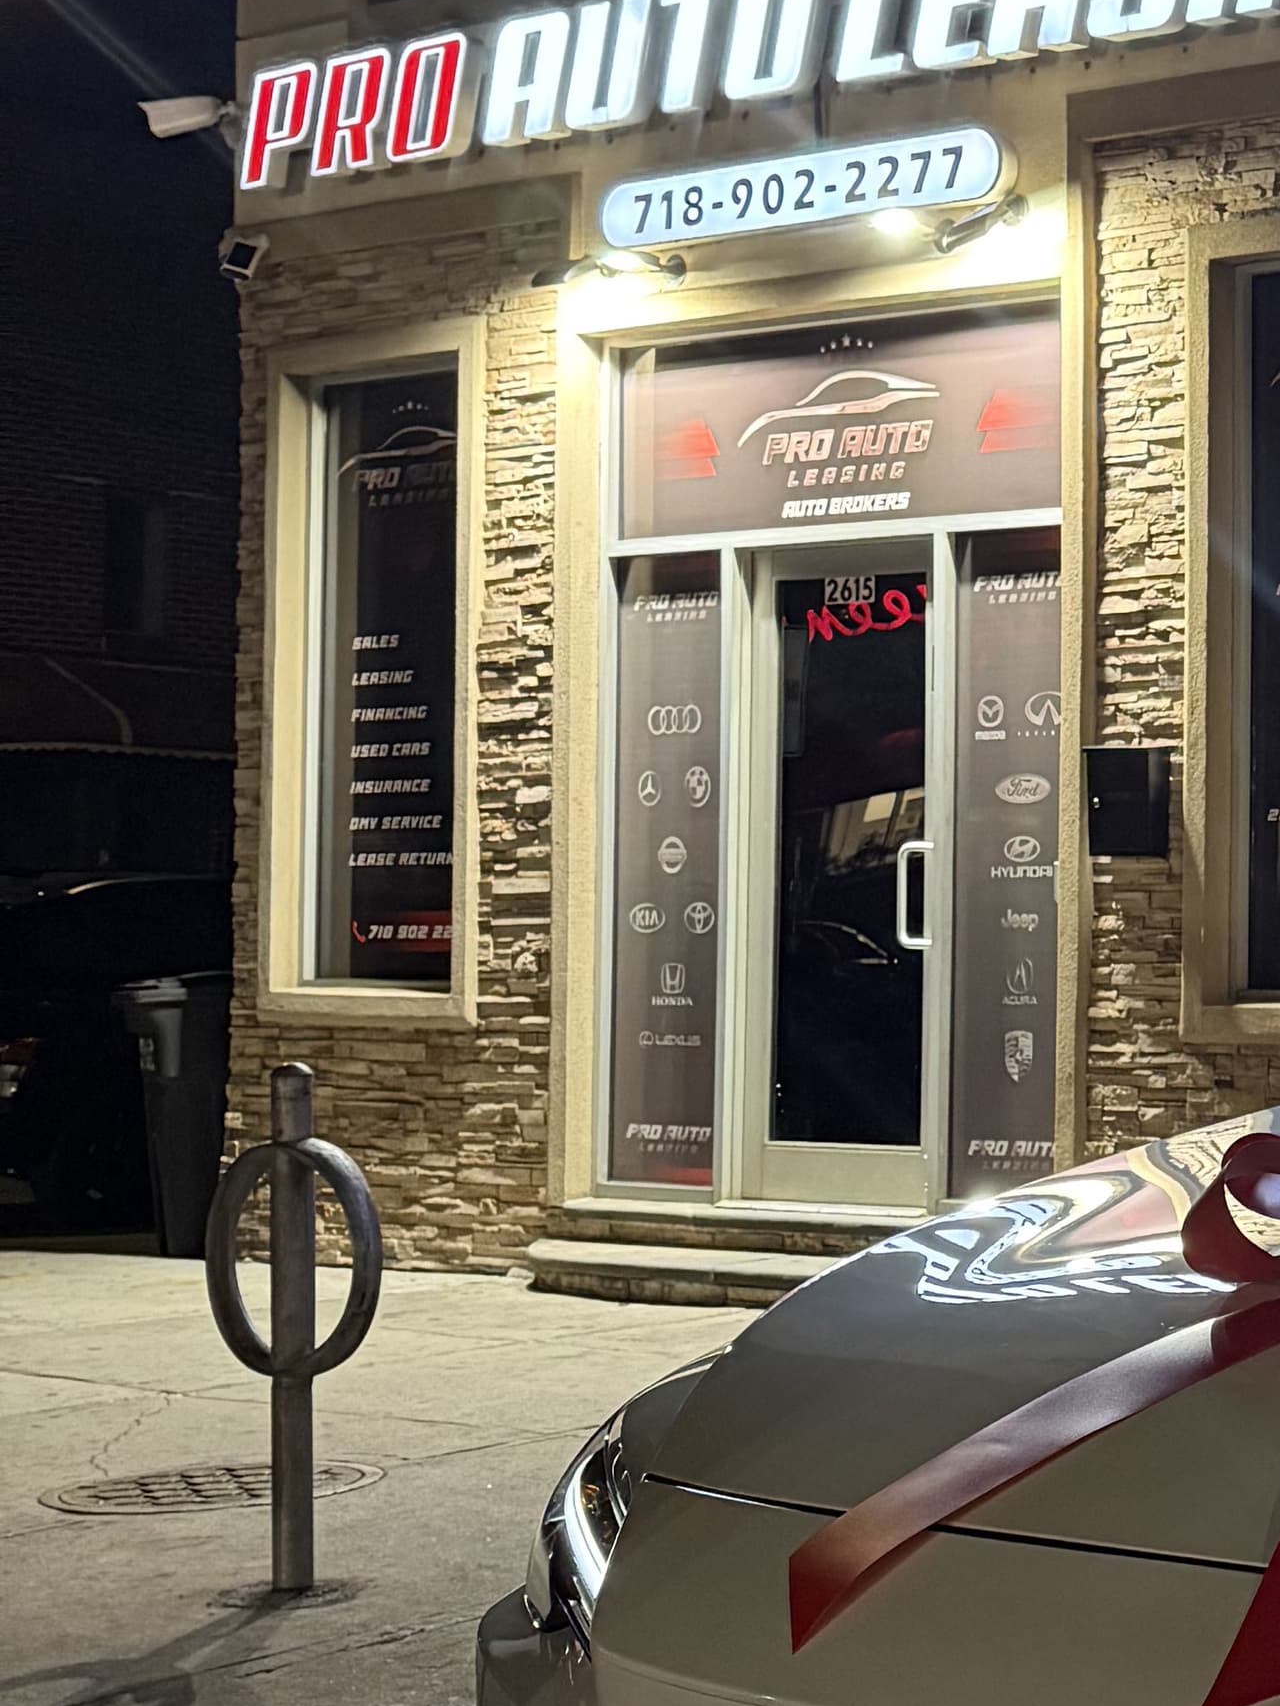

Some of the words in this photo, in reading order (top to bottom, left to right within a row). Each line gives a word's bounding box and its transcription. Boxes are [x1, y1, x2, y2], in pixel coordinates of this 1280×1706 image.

[240, 30, 467, 189] PRO
[632, 145, 967, 236] 718-902-2277
[762, 429, 834, 465] PRO
[838, 420, 933, 459] AUTO
[787, 461, 906, 488] LEASING
[782, 497, 828, 518] AUTO
[829, 492, 911, 515] BROKERS
[827, 578, 873, 602] 2615
[973, 575, 1015, 592] PRO
[633, 594, 670, 611] PRO
[672, 591, 718, 609] AUTO
[352, 635, 399, 650] SALES
[351, 670, 414, 686] LEASING
[350, 706, 428, 722] FINANCING
[350, 744, 389, 758] USED
[391, 742, 431, 756] CARS
[350, 779, 431, 794] INSURANCE
[1007, 778, 1039, 797] Ford
[349, 817, 378, 831] DMV
[381, 815, 443, 829] SERVICE
[348, 853, 396, 866] LEASE
[991, 866, 1053, 878] HYUNDAI
[635, 910, 660, 926] KIA
[1001, 909, 1039, 932] Jeep
[368, 925, 394, 939] 718
[397, 925, 429, 939] 902
[652, 996, 693, 1006] HONDA
[1002, 996, 1038, 1005] ACURA
[626, 1123, 662, 1141] PRO
[664, 1126, 712, 1141] AUTO
[968, 1140, 1008, 1156] PRO
